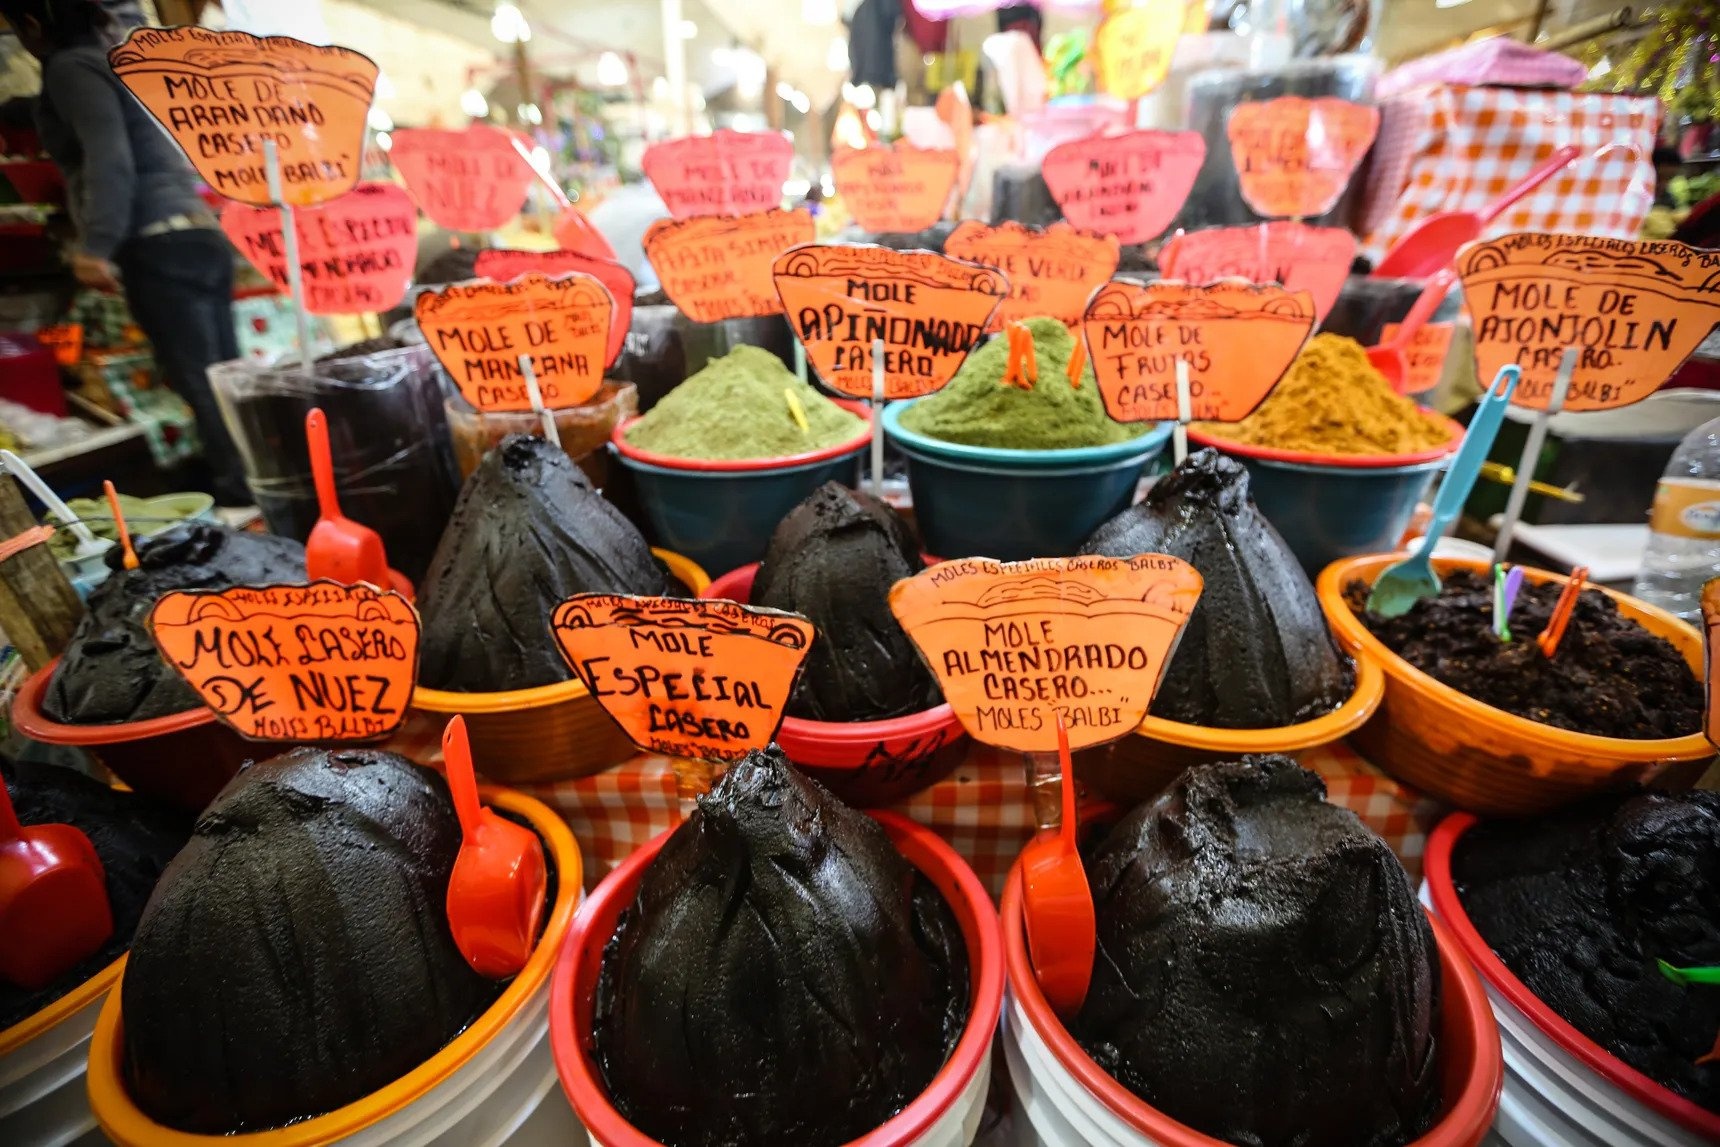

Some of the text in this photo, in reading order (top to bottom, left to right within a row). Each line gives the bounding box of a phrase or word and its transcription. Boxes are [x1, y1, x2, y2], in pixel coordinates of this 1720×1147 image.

[134, 30, 184, 52] MOLES
[163, 75, 286, 103] MOLE DE
[214, 167, 268, 188] MOLE
[847, 279, 917, 304] MOLE
[1491, 283, 1638, 315] MOLE DE
[436, 326, 514, 352] MOLE
[524, 320, 559, 347] DE
[1102, 323, 1203, 349] MOLE DE
[478, 384, 560, 407] CASEO
[930, 561, 978, 588] MOLES
[1066, 560, 1119, 572] CASEROS
[178, 624, 406, 669] MOLE CASERO
[629, 629, 714, 657] MOLE
[984, 620, 1055, 648] MOLE
[943, 644, 1148, 677] ALMENDRADO
[201, 670, 396, 715] DE NUEZ
[582, 657, 773, 710] ESPECIAL
[649, 703, 750, 742] CASERO
[976, 704, 1043, 731] MOLES
